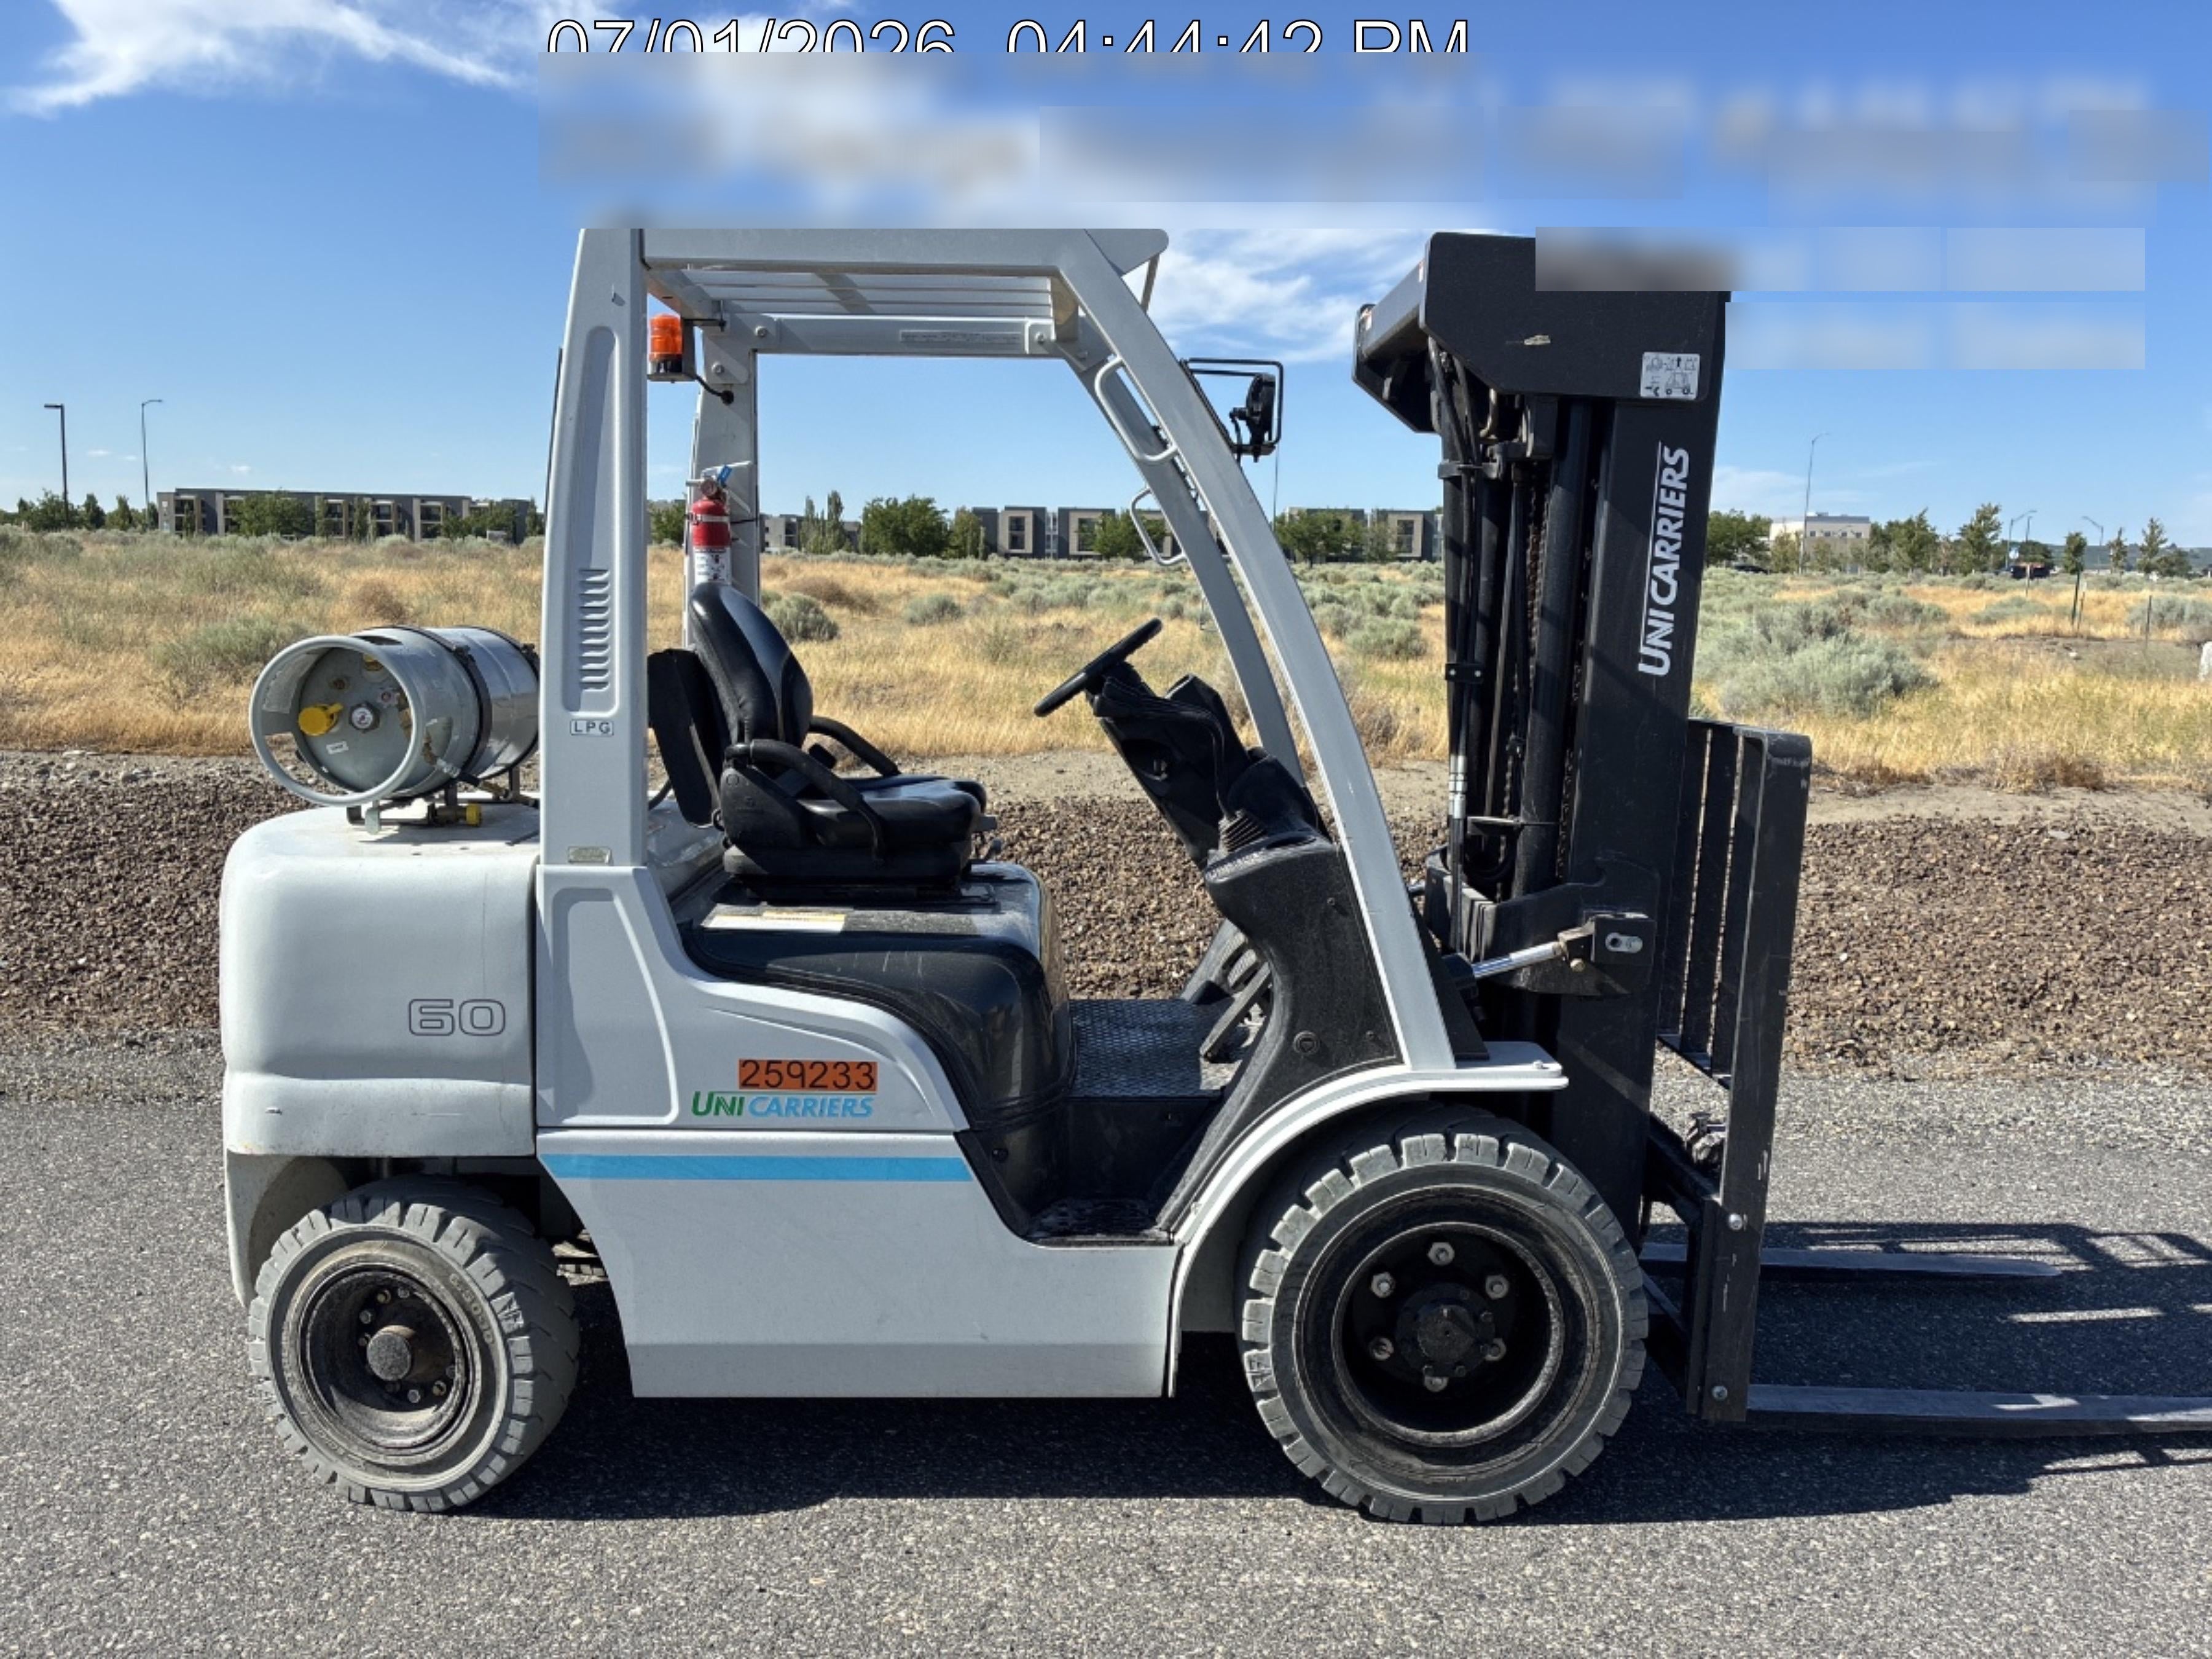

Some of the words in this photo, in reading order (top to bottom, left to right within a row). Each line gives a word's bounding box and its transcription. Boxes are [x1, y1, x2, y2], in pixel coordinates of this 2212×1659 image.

[575, 721, 611, 734] LPG
[408, 998, 506, 1037] 60
[740, 1059, 875, 1090] 259233
